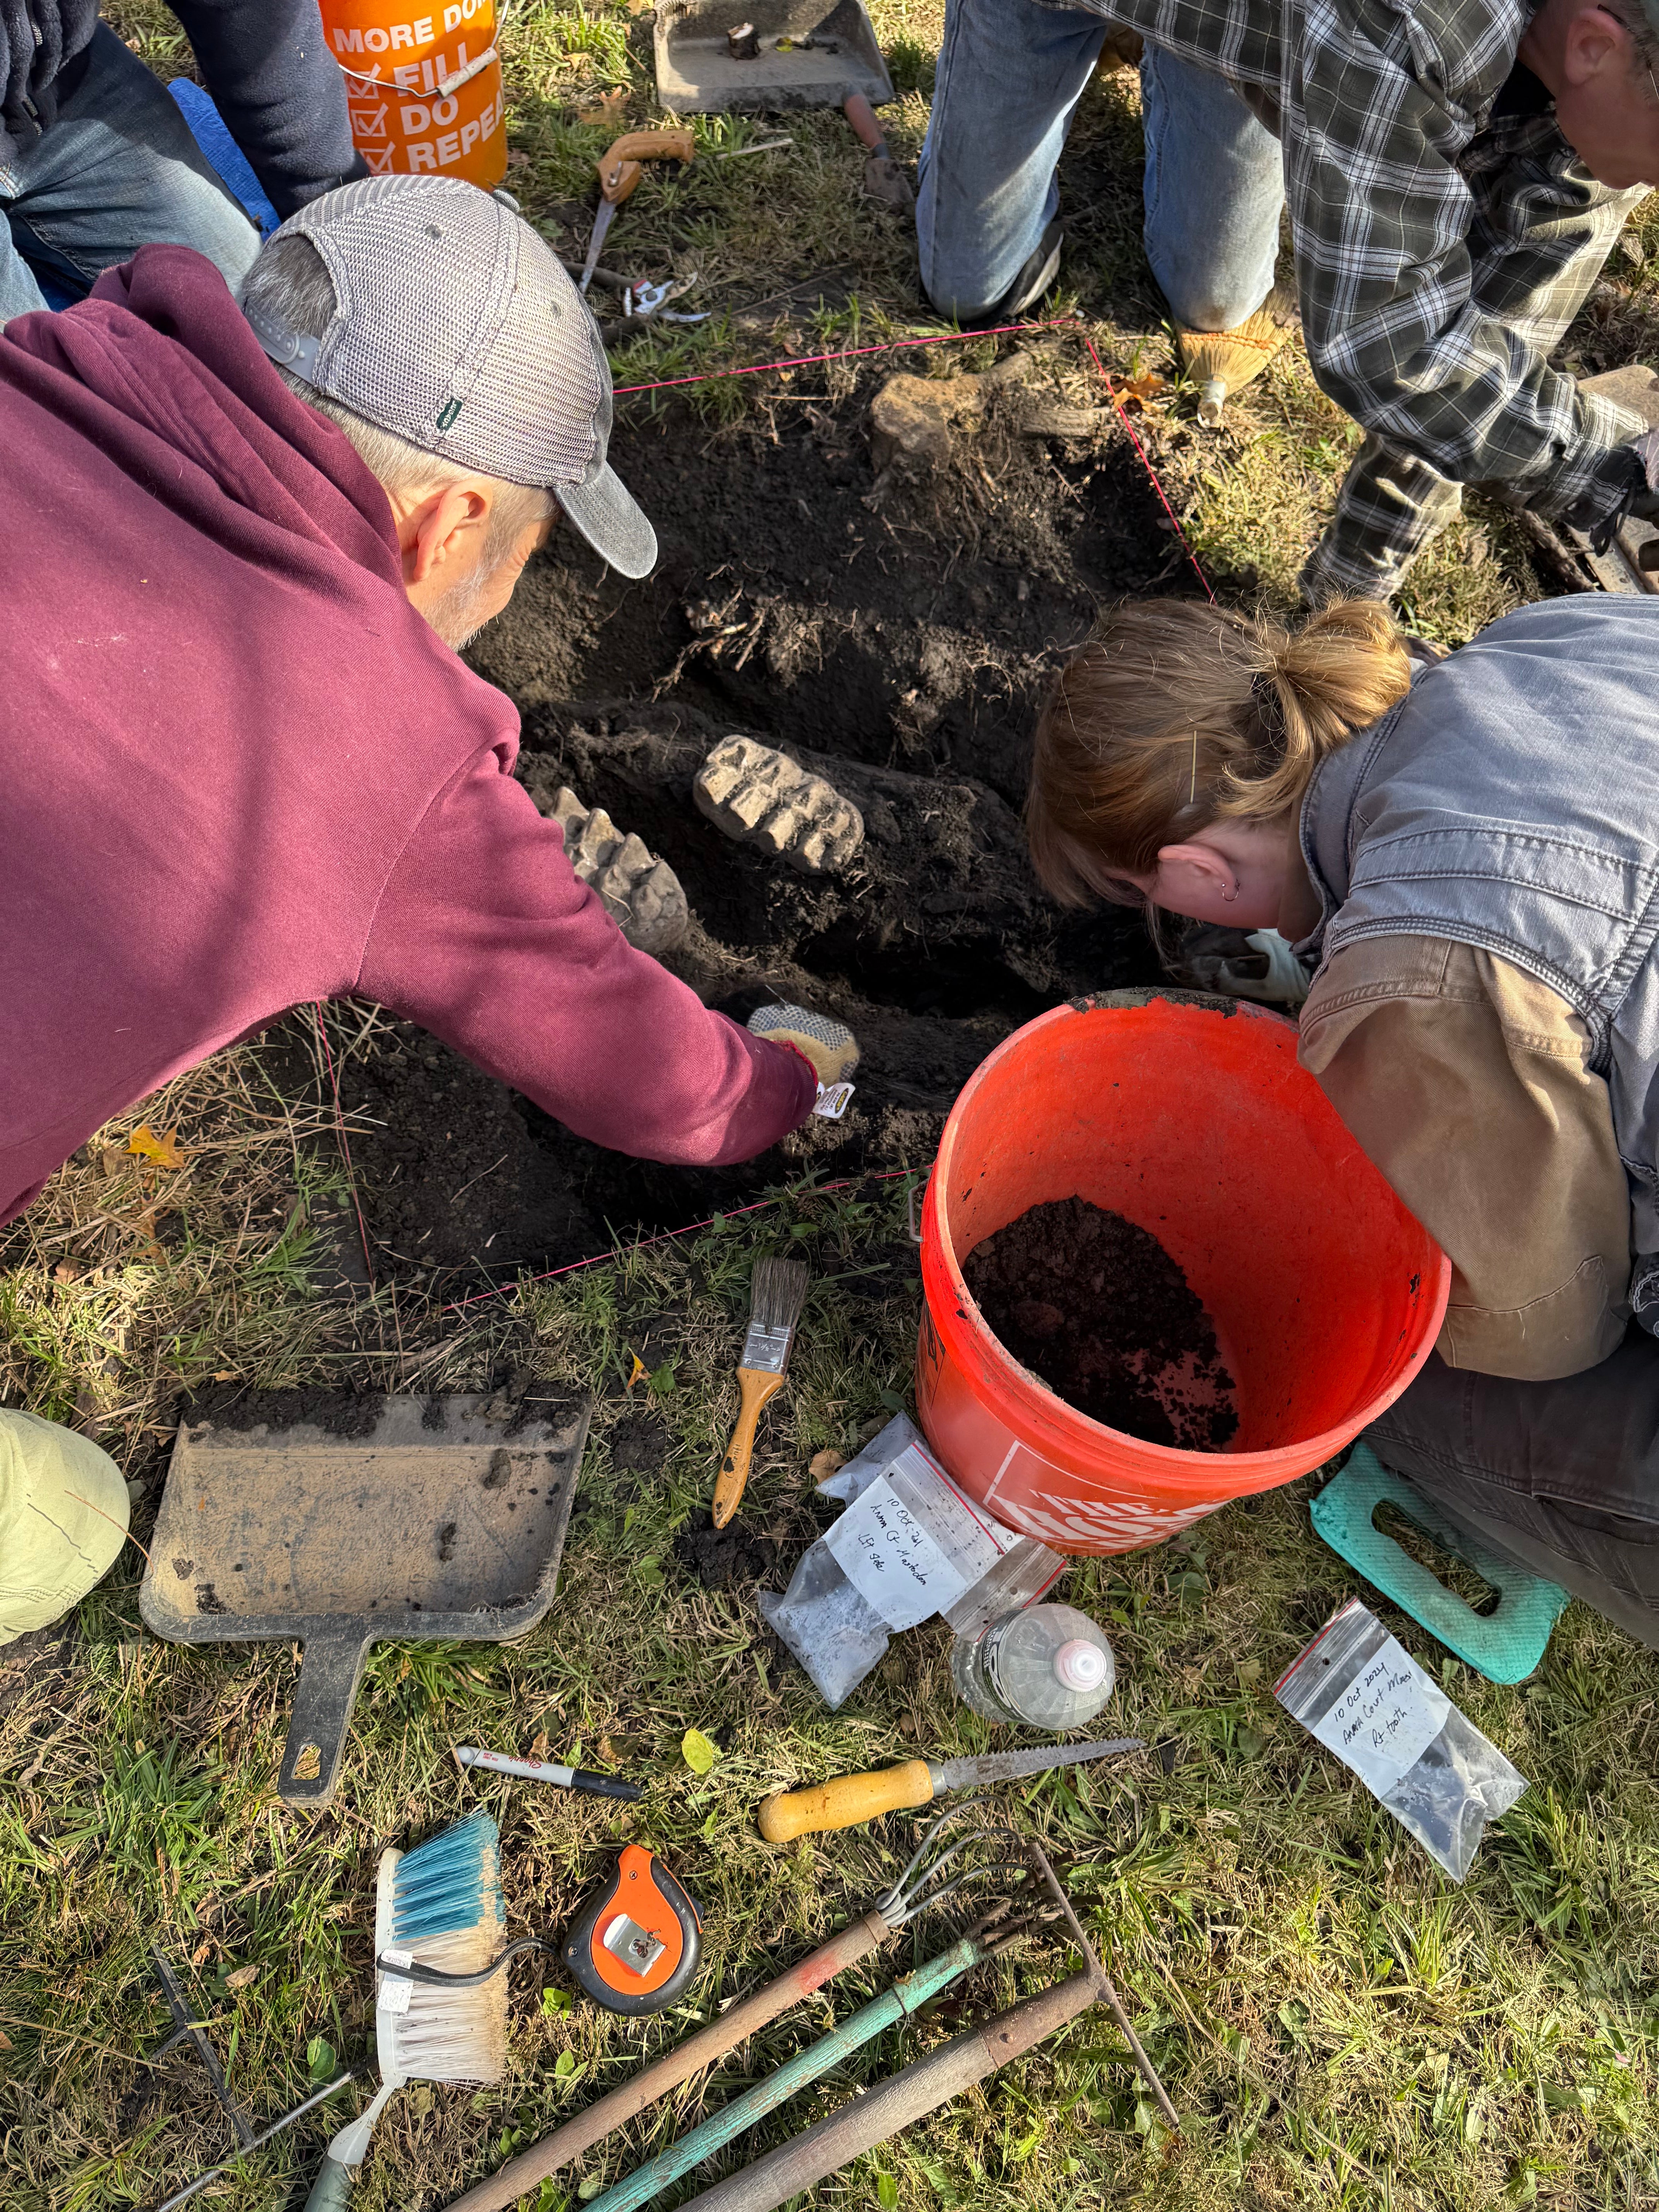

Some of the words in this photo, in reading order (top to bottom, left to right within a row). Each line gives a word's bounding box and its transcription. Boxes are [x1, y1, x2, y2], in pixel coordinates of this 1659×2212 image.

[333, 16, 435, 53] MORE
[400, 94, 459, 135] DO
[887, 1498, 900, 1506] 10
[896, 1510, 915, 1526] Oct
[1334, 1708, 1345, 1722] 10
[1347, 1686, 1361, 1707] Oct
[1364, 1662, 1389, 1687] 2024
